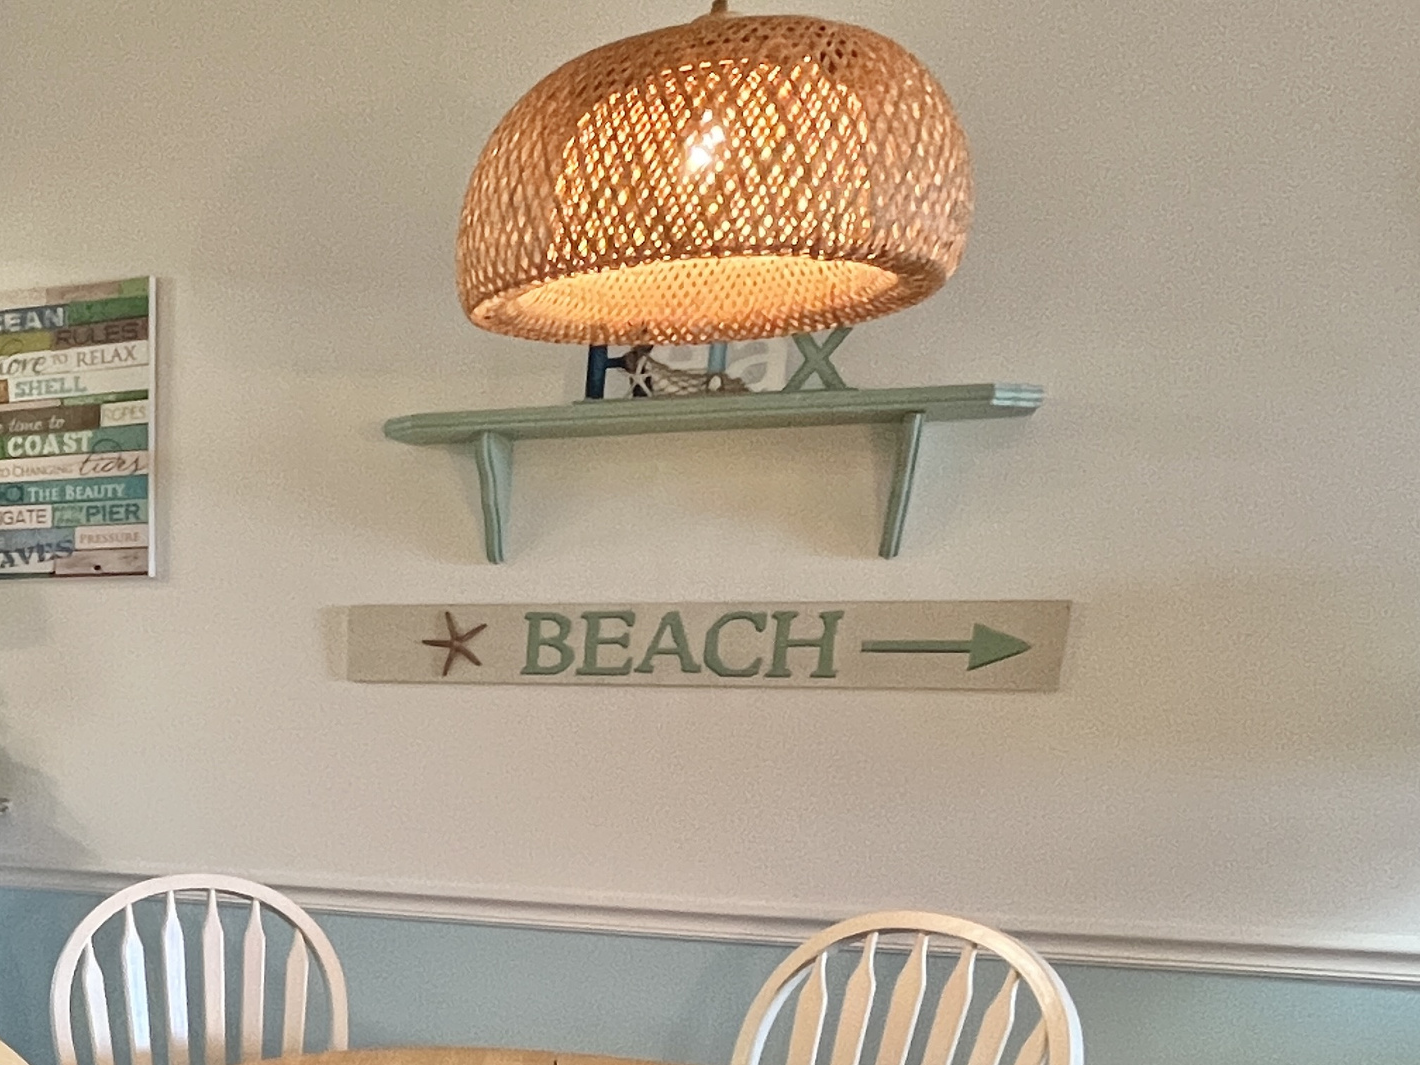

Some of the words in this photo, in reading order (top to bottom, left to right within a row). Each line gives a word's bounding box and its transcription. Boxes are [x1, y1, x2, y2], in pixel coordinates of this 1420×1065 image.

[55, 321, 142, 347] RULES
[52, 354, 69, 366] TO
[76, 345, 137, 368] RELAX
[14, 375, 88, 399] SHELL
[48, 415, 66, 429] to
[7, 430, 94, 457] COAST
[28, 487, 60, 503] THE
[65, 483, 126, 500] BEAUTY
[85, 503, 141, 523] PIER
[79, 531, 141, 545] PRESSURE
[520, 610, 844, 678] BEACH
